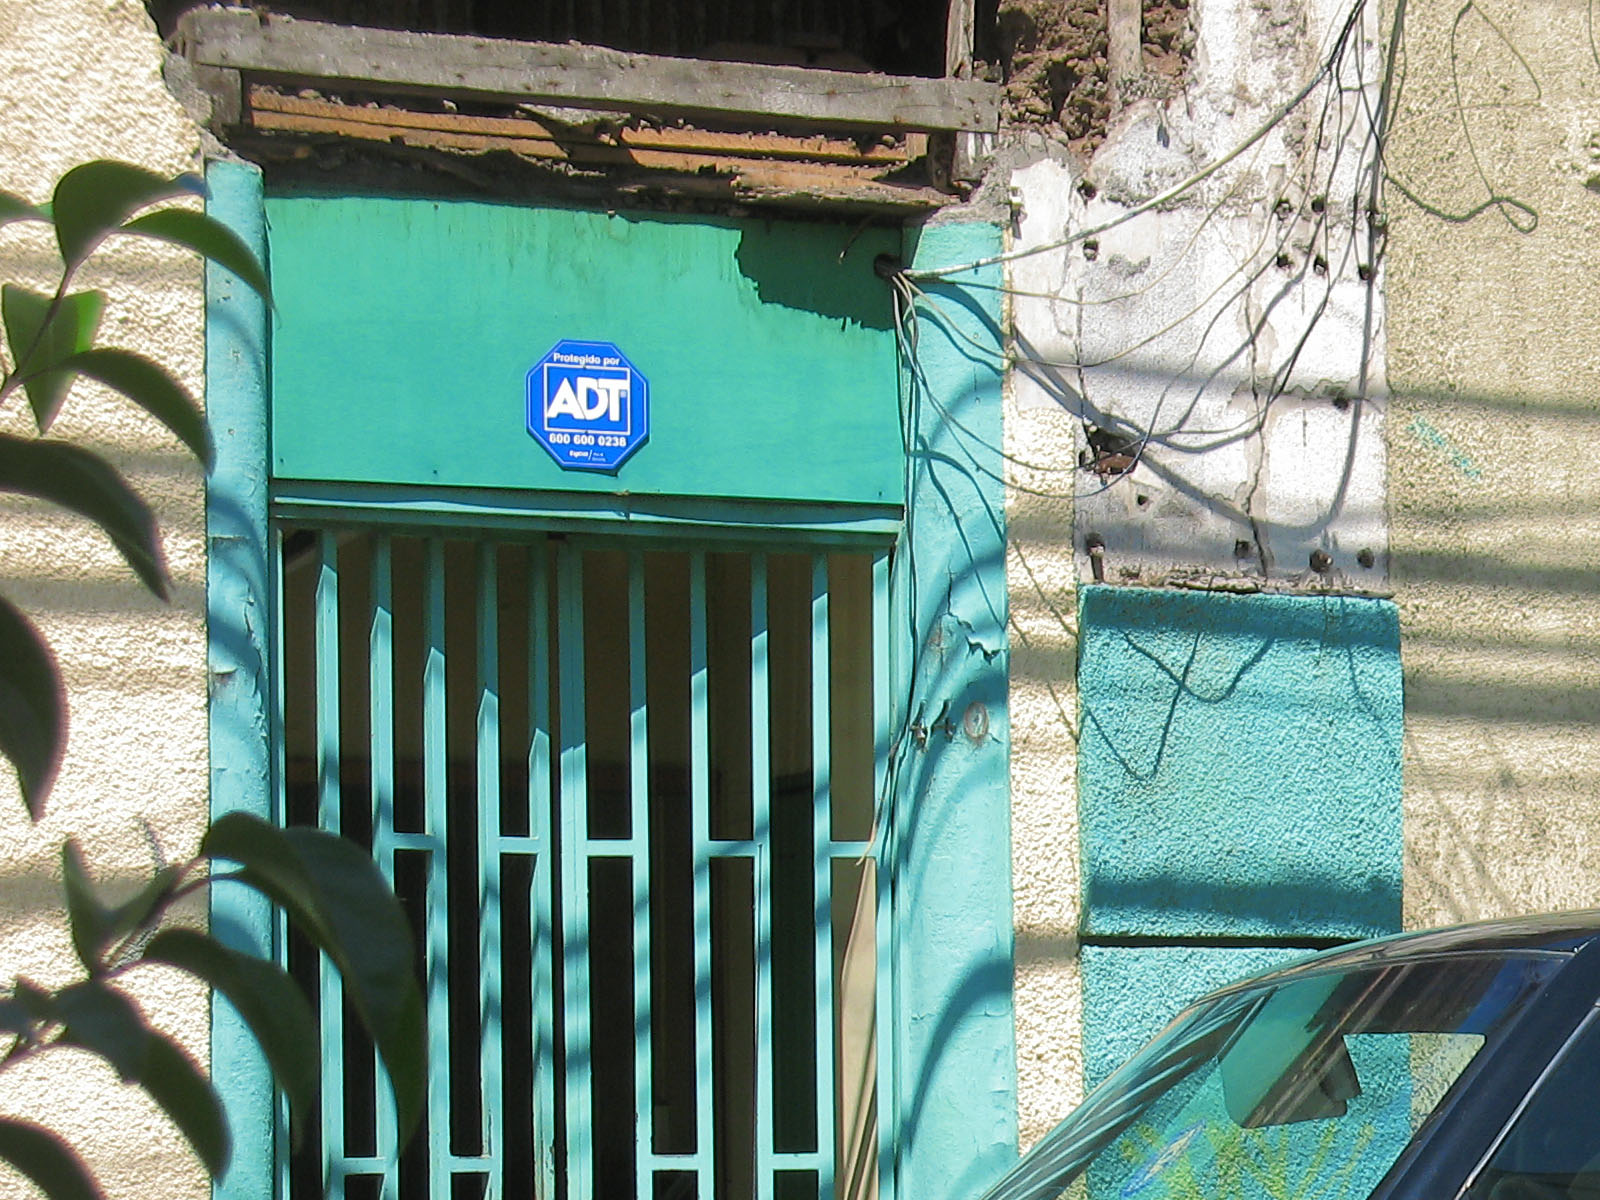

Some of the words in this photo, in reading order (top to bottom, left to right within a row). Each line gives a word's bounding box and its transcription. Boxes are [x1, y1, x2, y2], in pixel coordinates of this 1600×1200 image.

[553, 352, 601, 364] Protegido
[603, 358, 620, 366] por
[547, 377, 628, 421] ADT
[549, 433, 571, 445] 600
[573, 434, 595, 445] 600
[598, 436, 627, 446] 0238
